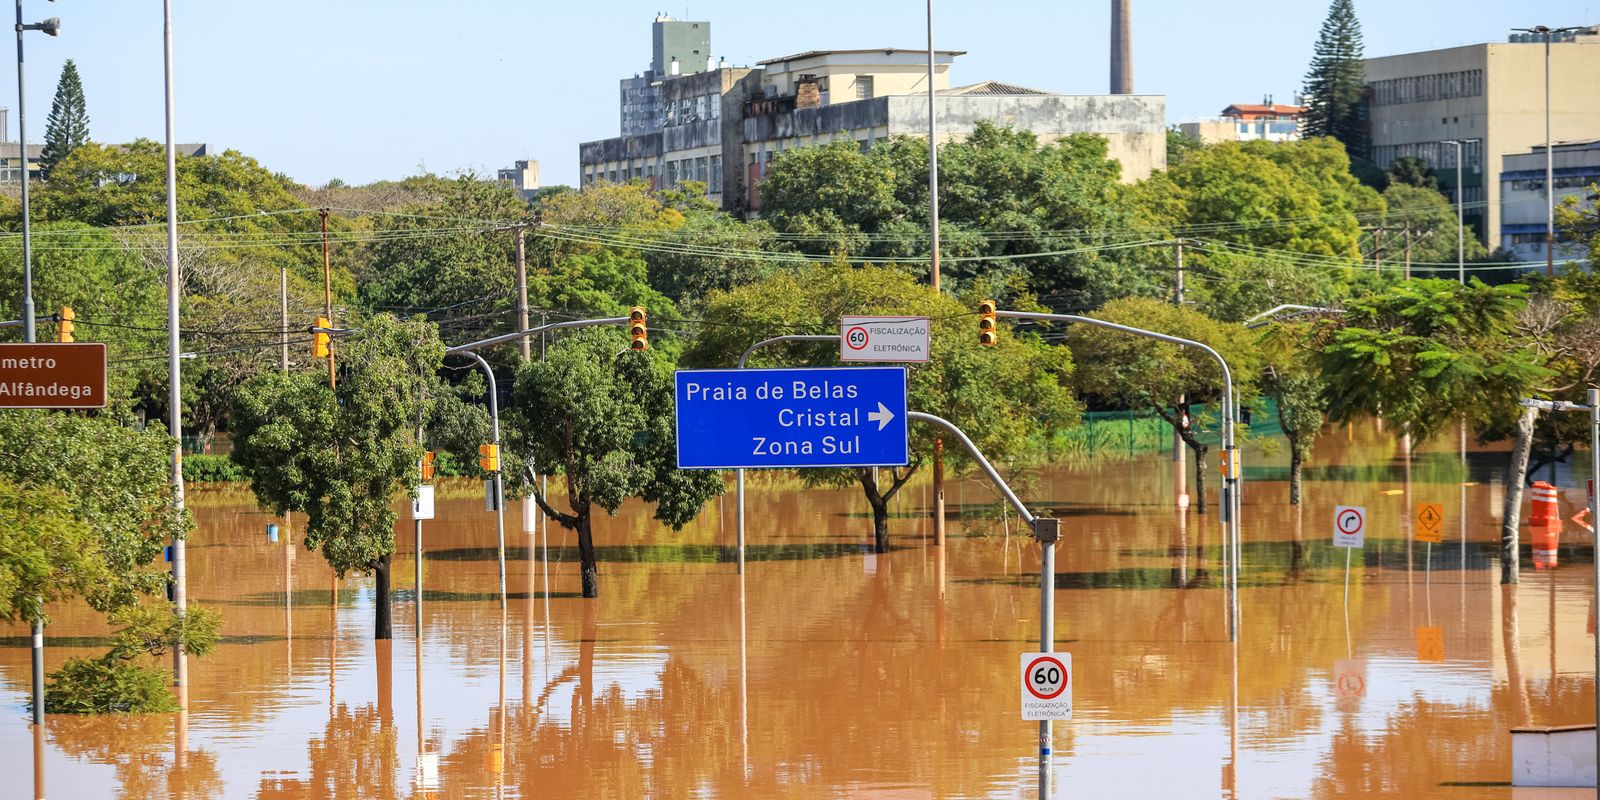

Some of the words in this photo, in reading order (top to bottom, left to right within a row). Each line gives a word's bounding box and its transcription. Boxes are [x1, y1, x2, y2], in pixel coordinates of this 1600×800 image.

[850, 332, 865, 342] 60
[870, 327, 926, 336] FISCALIZAÇÃO
[873, 344, 921, 352] ELETRÔNICA
[1, 356, 57, 369] metro
[0, 382, 92, 400] Alfândega
[686, 381, 747, 401] Praia
[756, 381, 784, 400] de
[792, 380, 858, 399] Belas
[778, 408, 859, 427] Cristal
[752, 437, 813, 456] Zona
[822, 435, 860, 455] Sul
[1034, 667, 1060, 685] 60
[1024, 701, 1068, 709] FISCALIZAÇÃO
